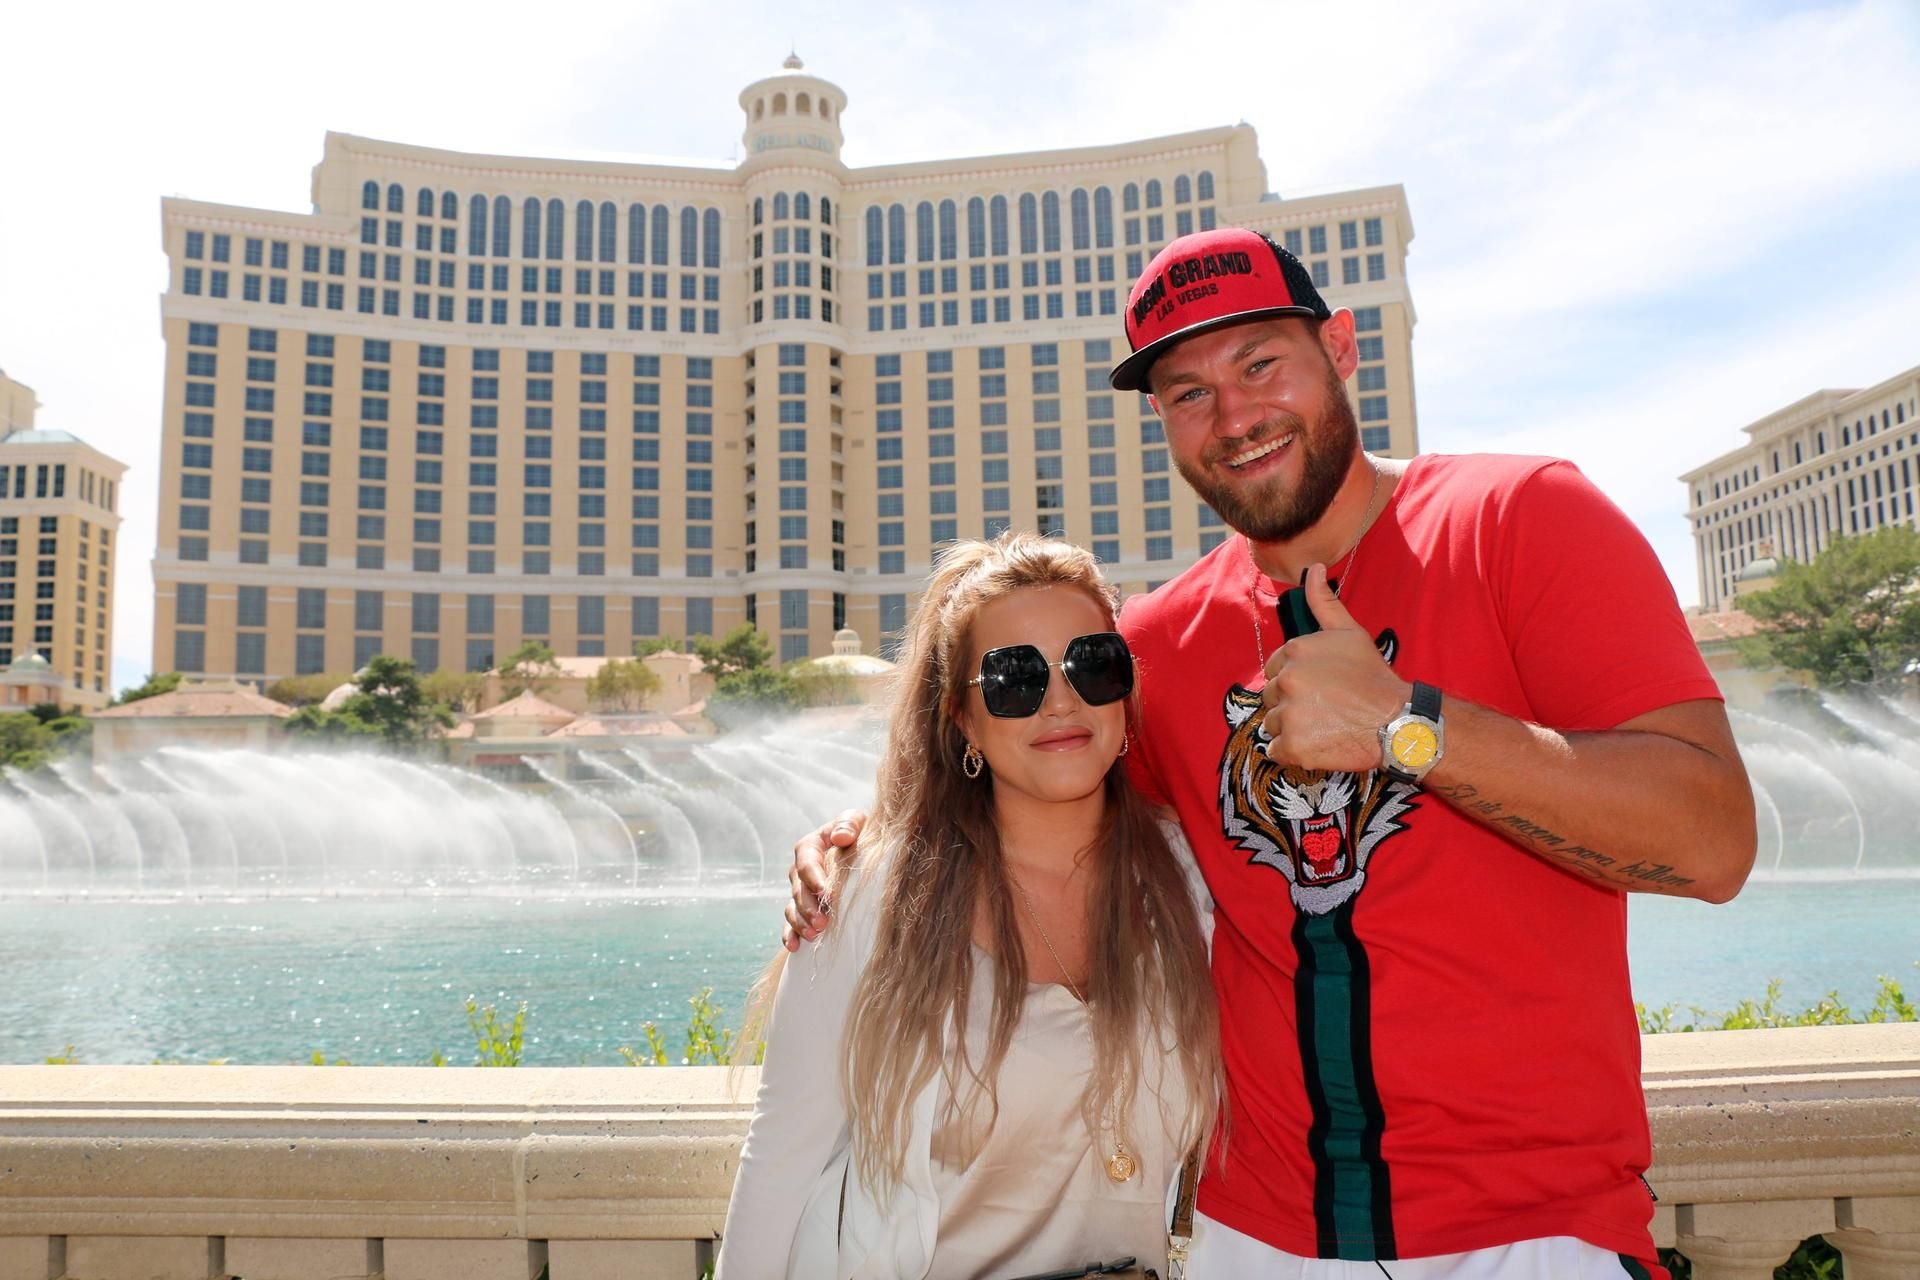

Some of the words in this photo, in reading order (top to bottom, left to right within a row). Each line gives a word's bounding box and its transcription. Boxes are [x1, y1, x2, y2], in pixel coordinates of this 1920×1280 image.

[1132, 275, 1166, 328] MGM
[1169, 252, 1251, 288] GRAND
[1156, 300, 1175, 321] LAS
[1176, 283, 1219, 305] VEGAS
